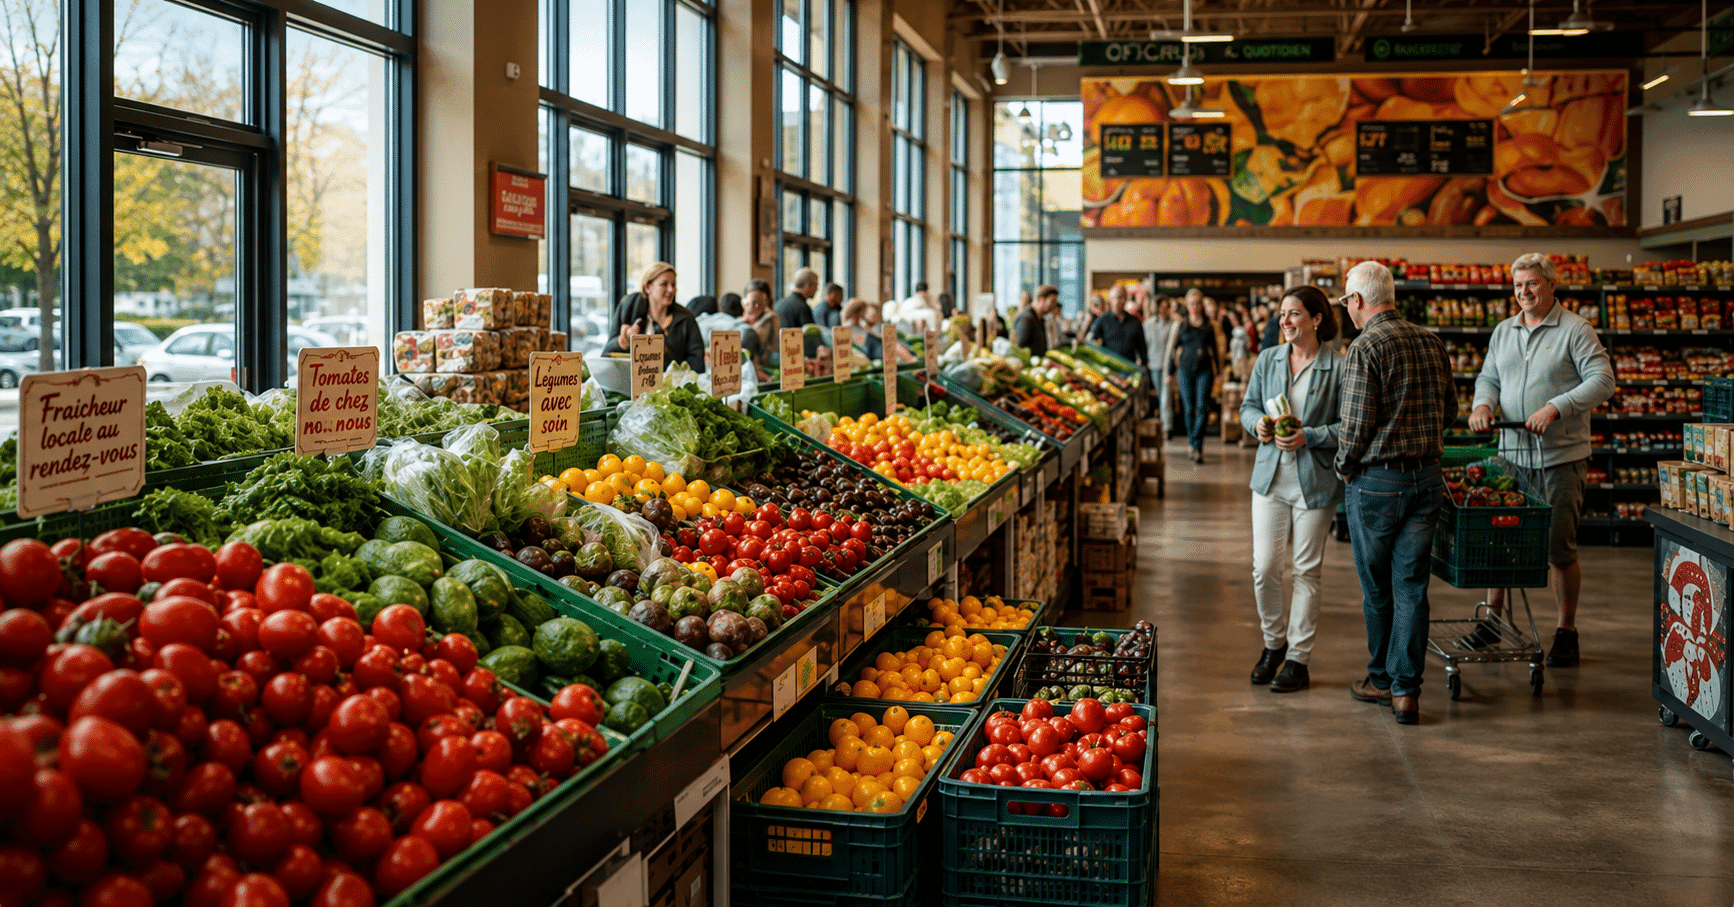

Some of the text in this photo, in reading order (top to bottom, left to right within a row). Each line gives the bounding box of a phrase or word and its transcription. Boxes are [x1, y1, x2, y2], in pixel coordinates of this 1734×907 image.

[309, 363, 369, 387] Tomates
[535, 365, 578, 394] Légumes
[309, 389, 369, 412] de chez
[541, 395, 572, 412] avec
[40, 421, 120, 450] locale au
[335, 416, 371, 432] nous
[541, 414, 568, 434] soin
[29, 443, 138, 480] rendez-vous
